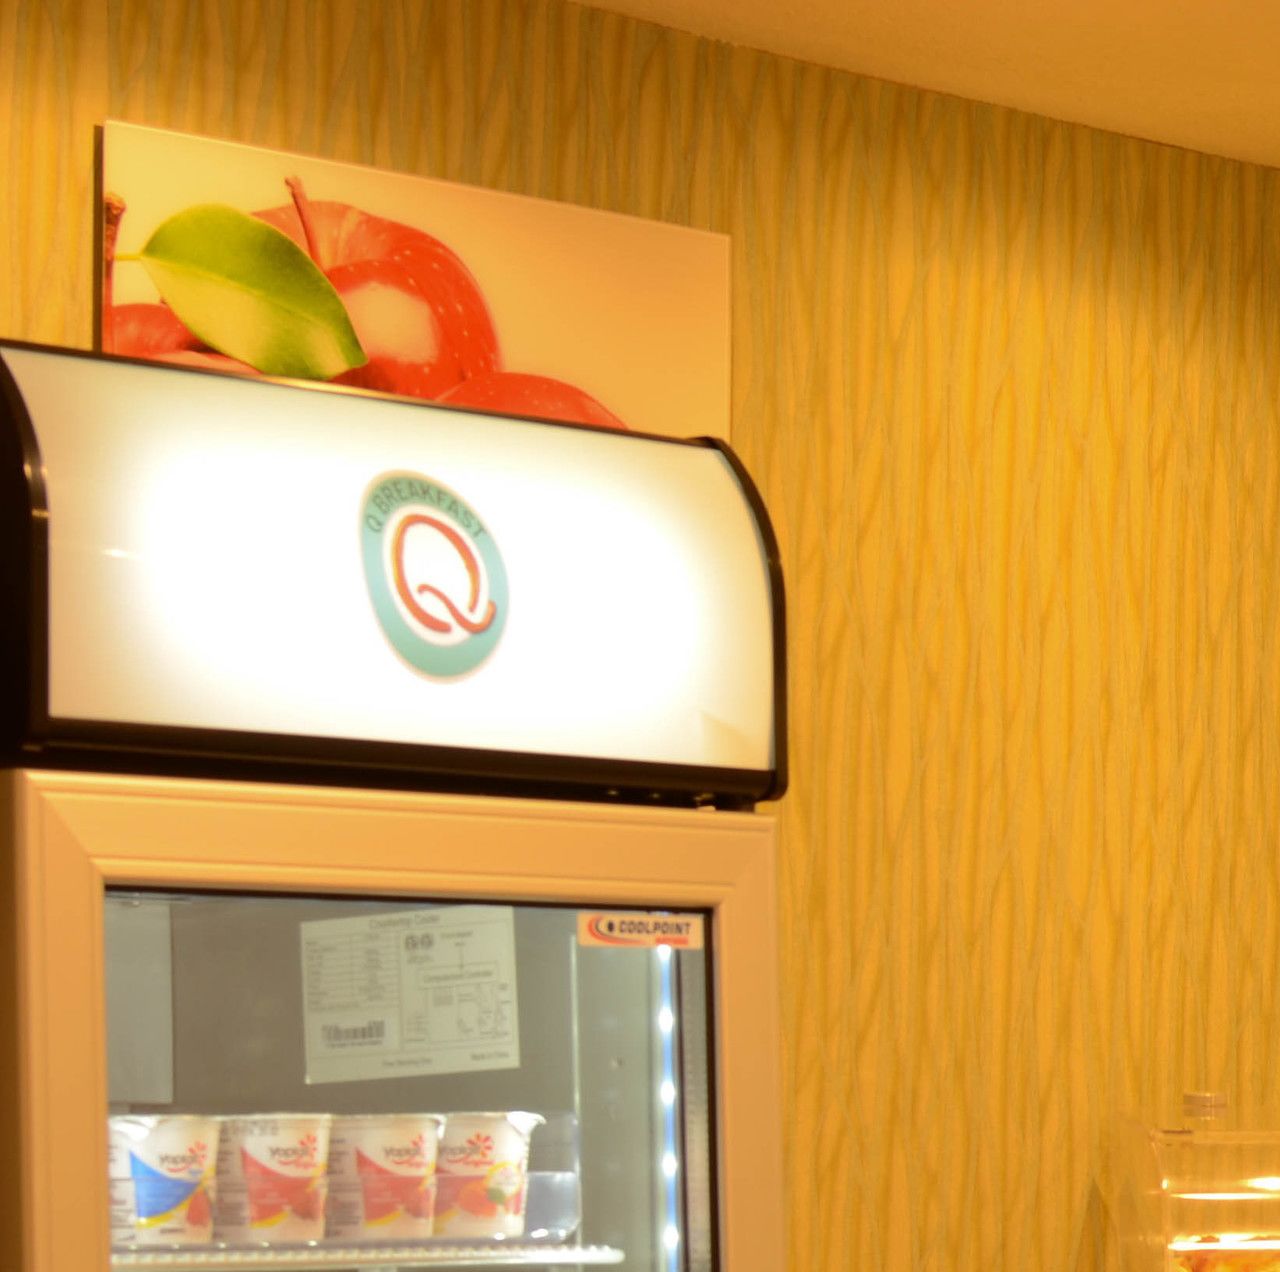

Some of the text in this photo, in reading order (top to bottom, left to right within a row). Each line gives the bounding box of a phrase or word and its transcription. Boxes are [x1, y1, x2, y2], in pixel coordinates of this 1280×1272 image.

[373, 480, 486, 538] BREAKFAST
[391, 513, 497, 634] Q
[619, 919, 692, 934] COOLPOINT
